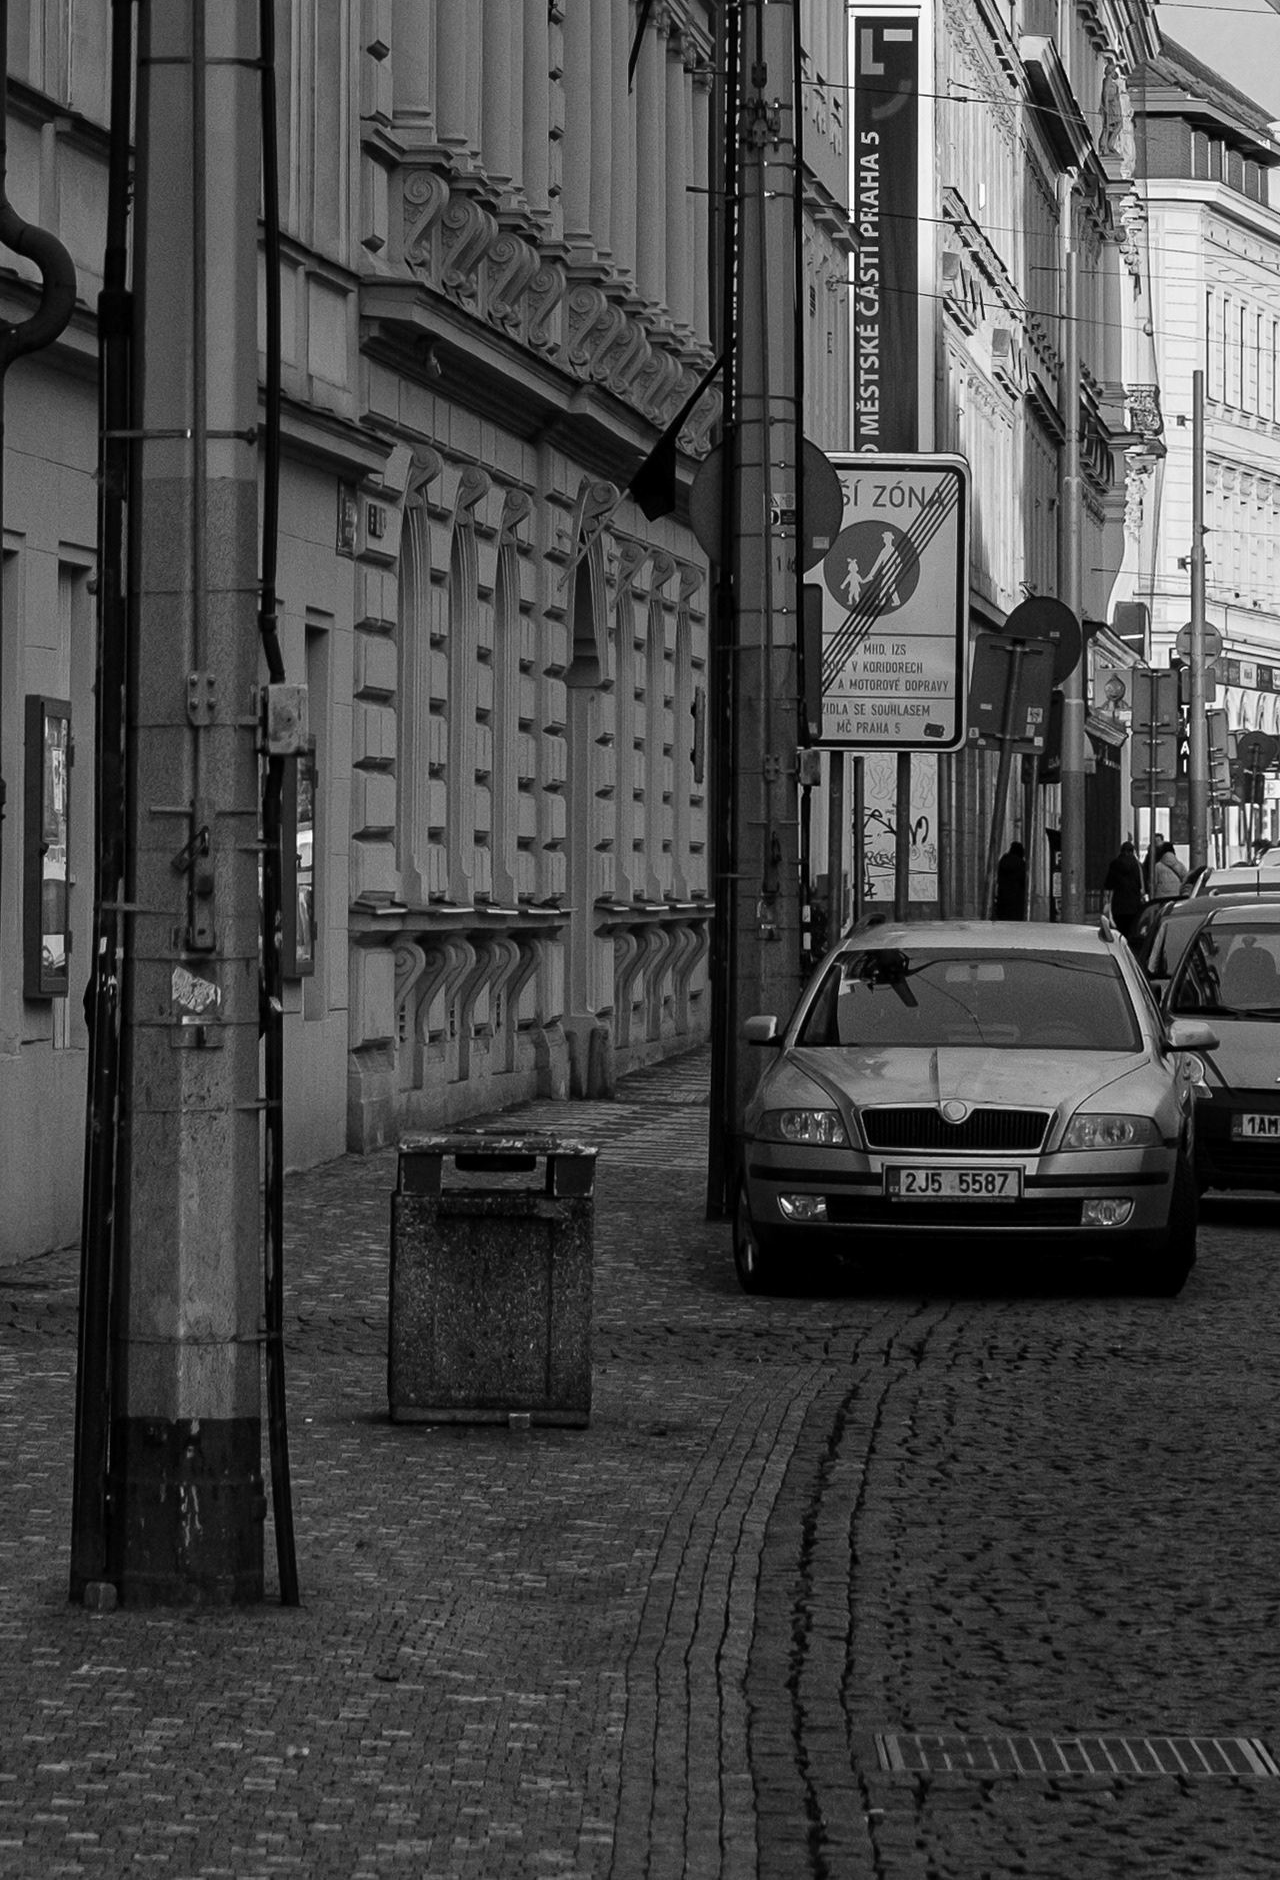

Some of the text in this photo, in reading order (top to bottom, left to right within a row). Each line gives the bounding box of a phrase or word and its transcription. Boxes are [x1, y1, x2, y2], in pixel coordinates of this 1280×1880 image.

[861, 131, 879, 145] 5
[860, 153, 879, 237] PRAHA
[856, 246, 879, 316] ČÁSTI
[856, 324, 879, 435] MĚSTSKÉ
[891, 644, 906, 656] IZS
[852, 661, 858, 672] V
[863, 662, 923, 674] KORIDORECH
[838, 677, 949, 692] A MOTOROVÉ DOPRAVY
[854, 704, 866, 715] SE
[871, 704, 930, 716] SOUHLASEM
[837, 720, 901, 734] MČ PRAHA 5
[1247, 1116, 1279, 1134] 1AM
[905, 1172, 942, 1193] 2J5
[958, 1173, 1009, 1193] 5587
